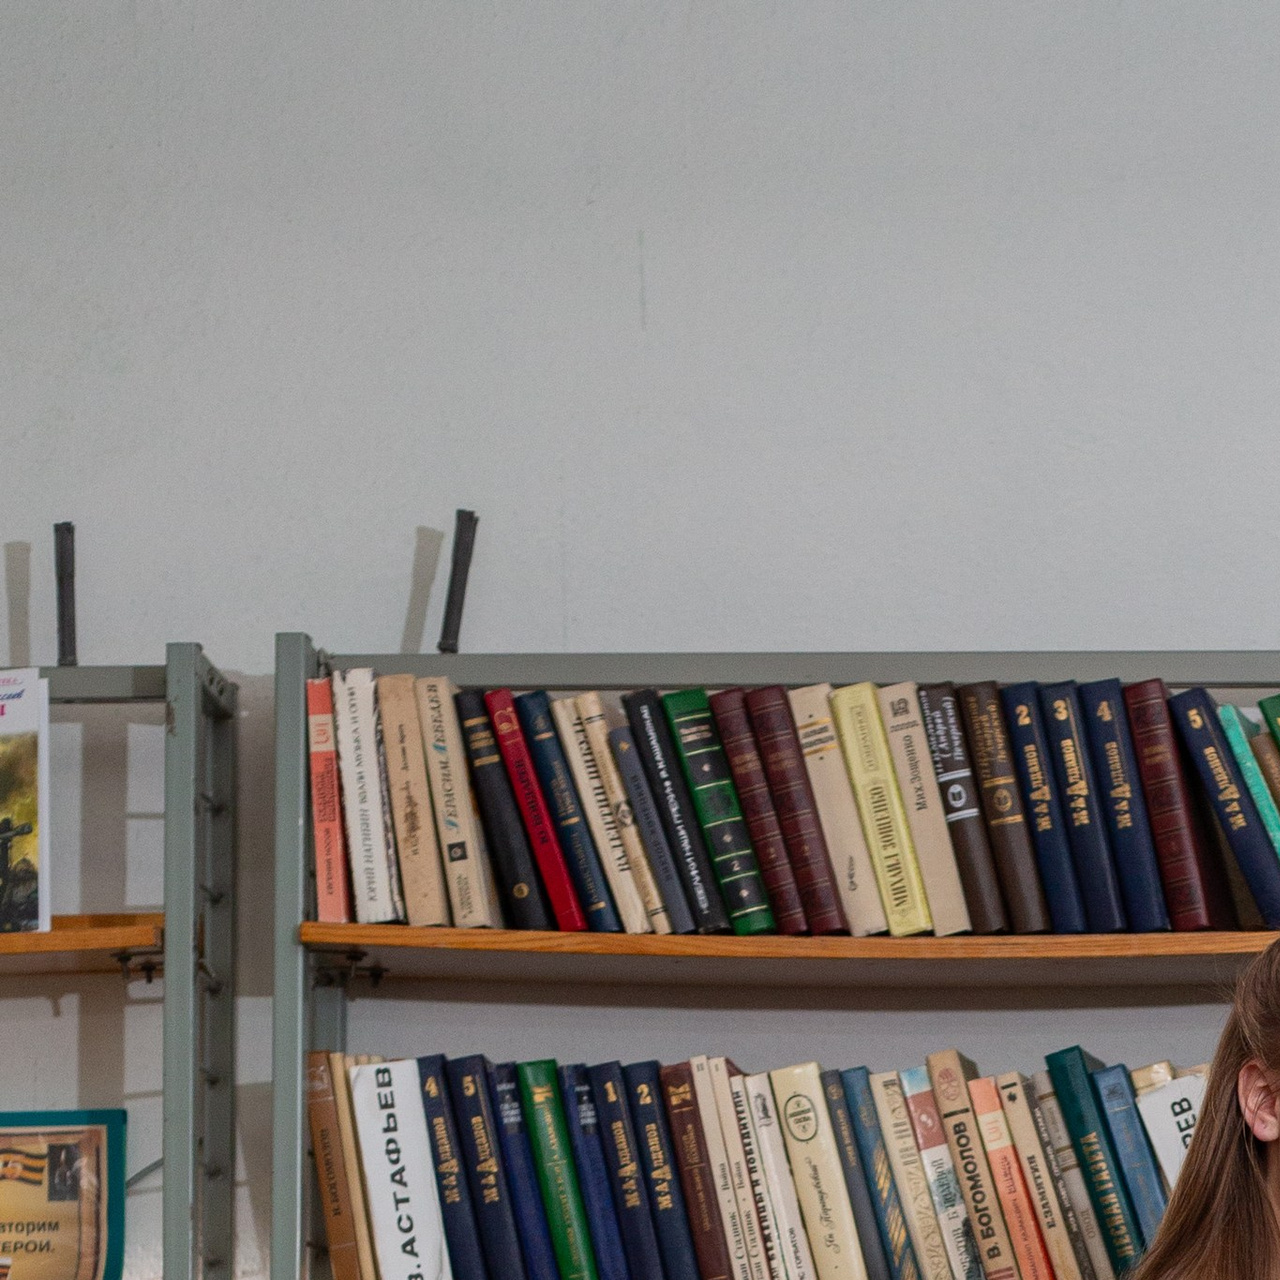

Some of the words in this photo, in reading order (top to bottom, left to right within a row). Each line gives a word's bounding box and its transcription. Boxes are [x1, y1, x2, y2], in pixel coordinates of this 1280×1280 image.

[427, 684, 448, 754] ЛЕБЕДЕВ
[1017, 705, 1030, 725] 2
[1055, 700, 1067, 720] 3
[1097, 702, 1112, 721] 4
[1187, 709, 1203, 729] 5
[573, 717, 601, 780] ПИКУЛЬ
[591, 785, 631, 872] ВАЛЕНТИН
[869, 786, 898, 849] ЗОЩЕНКО
[883, 853, 909, 908] МИХАИЛ
[425, 1076, 438, 1097] 4
[463, 1075, 475, 1096] 5
[605, 1081, 617, 1102] 1
[638, 1084, 651, 1104] 2
[732, 1090, 758, 1173] ПОБЕДИТЕЛИ
[718, 1163, 730, 1191] Война
[733, 1161, 745, 1189] Война
[952, 1121, 995, 1238] БОГОМОЛОВ
[1081, 1131, 1115, 1190] ГАЗЕТА
[751, 1178, 760, 1186] И
[728, 1211, 745, 1260] Стаднюк
[743, 1210, 760, 1258] Стаднюк
[754, 1191, 776, 1261] БЕЖЕНЦЫ
[1100, 1193, 1135, 1257] ЛЕСНАЯ
[787, 1227, 803, 1269] ГОРБАТОВ
[985, 1238, 1001, 1258] В.
